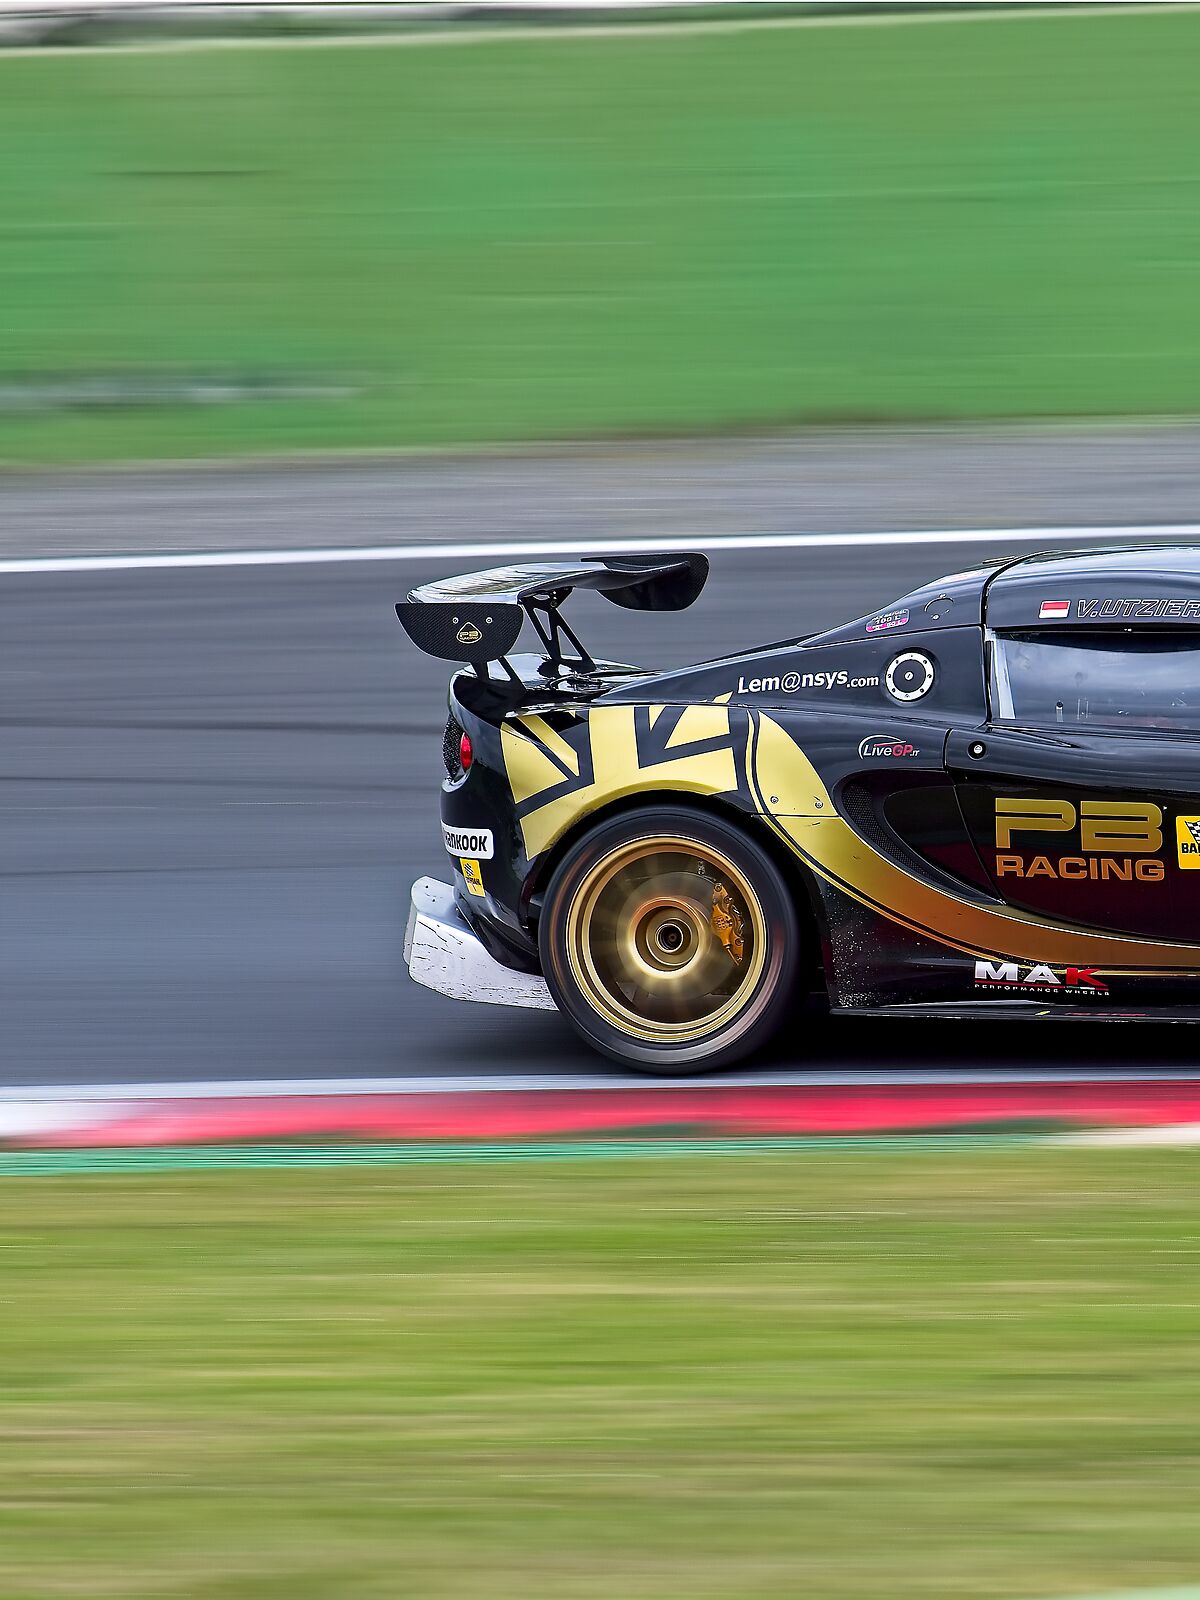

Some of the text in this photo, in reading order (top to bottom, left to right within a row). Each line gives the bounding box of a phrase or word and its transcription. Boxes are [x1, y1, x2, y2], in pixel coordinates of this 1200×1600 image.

[737, 670, 880, 693] Lem@nsys.com
[995, 797, 1164, 852] PB
[996, 854, 1165, 882] RACING
[974, 960, 1109, 988] MAK
